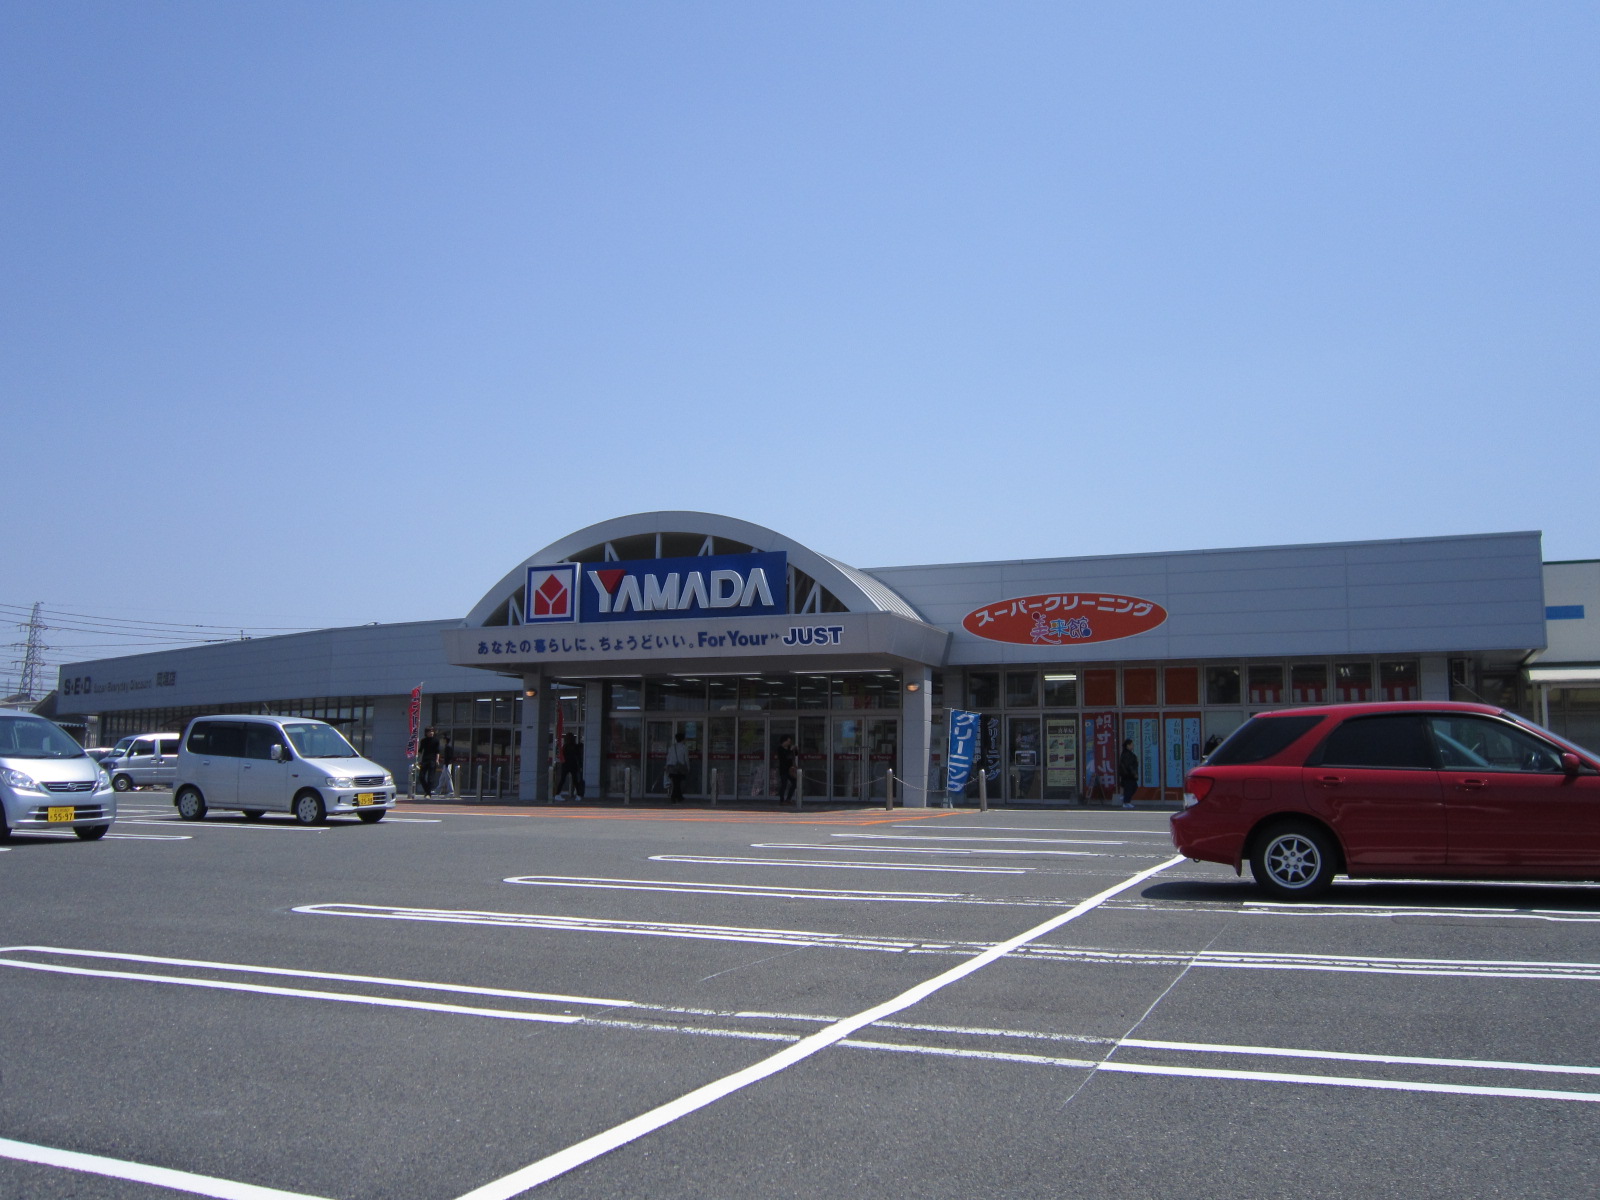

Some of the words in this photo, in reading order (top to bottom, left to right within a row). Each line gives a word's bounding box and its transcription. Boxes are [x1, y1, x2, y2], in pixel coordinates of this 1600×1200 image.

[587, 567, 775, 613] YAMADA
[975, 595, 1154, 627] スーパークリーニング
[477, 634, 694, 655] あなたの暮らしに、ちょうどいい。
[697, 631, 725, 648] For
[727, 630, 768, 647] Your
[782, 625, 845, 647] JUST
[1030, 611, 1092, 645] 美来館
